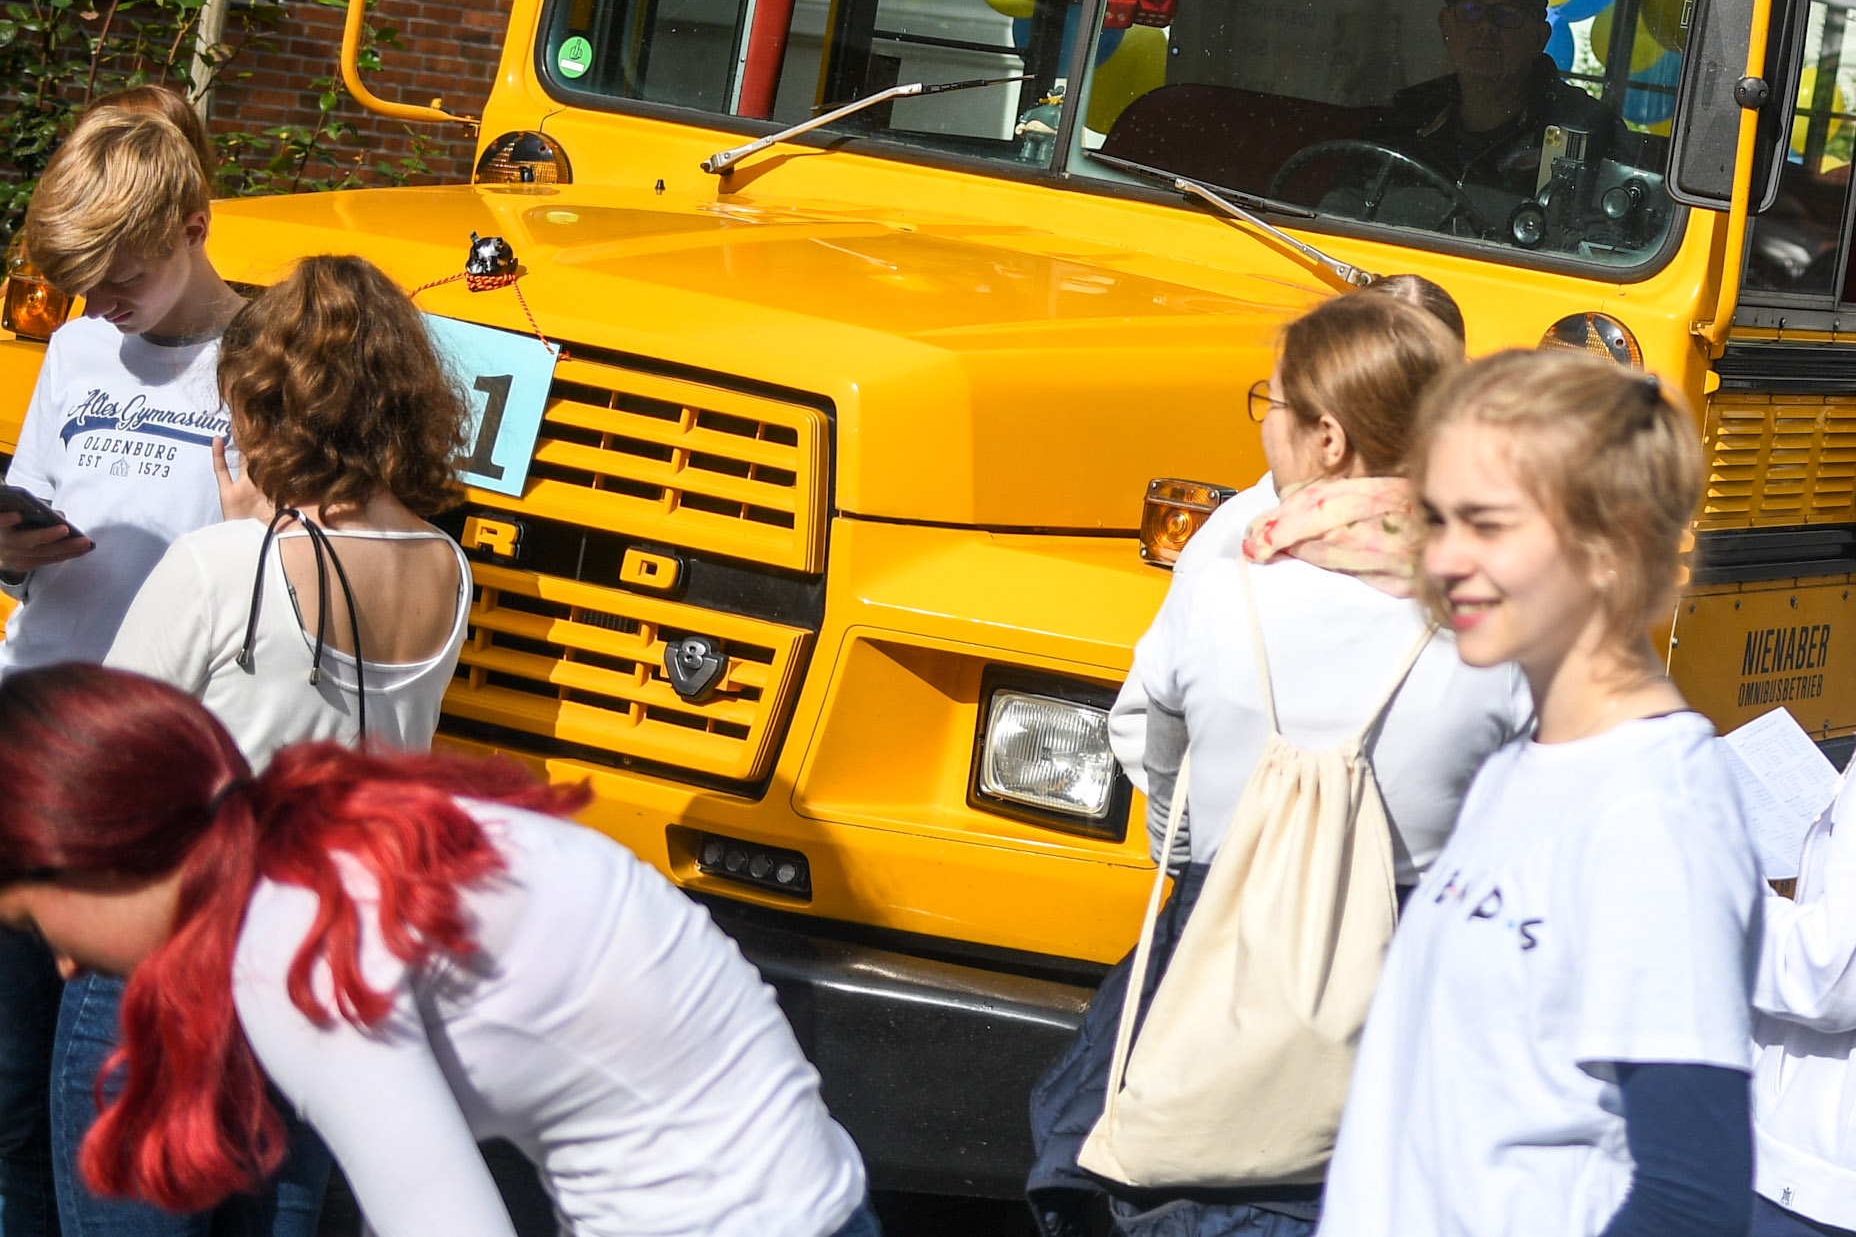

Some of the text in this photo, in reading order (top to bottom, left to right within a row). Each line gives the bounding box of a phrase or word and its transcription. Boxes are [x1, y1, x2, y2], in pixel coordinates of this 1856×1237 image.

[67, 389, 232, 434] Altes Gymnasium
[454, 373, 514, 481] 1
[78, 453, 171, 478] EST 1573
[83, 436, 178, 461] OLDENBURG
[1742, 624, 1831, 676] NIENABER
[1738, 673, 1824, 707] OMNIBUSBETRIEB
